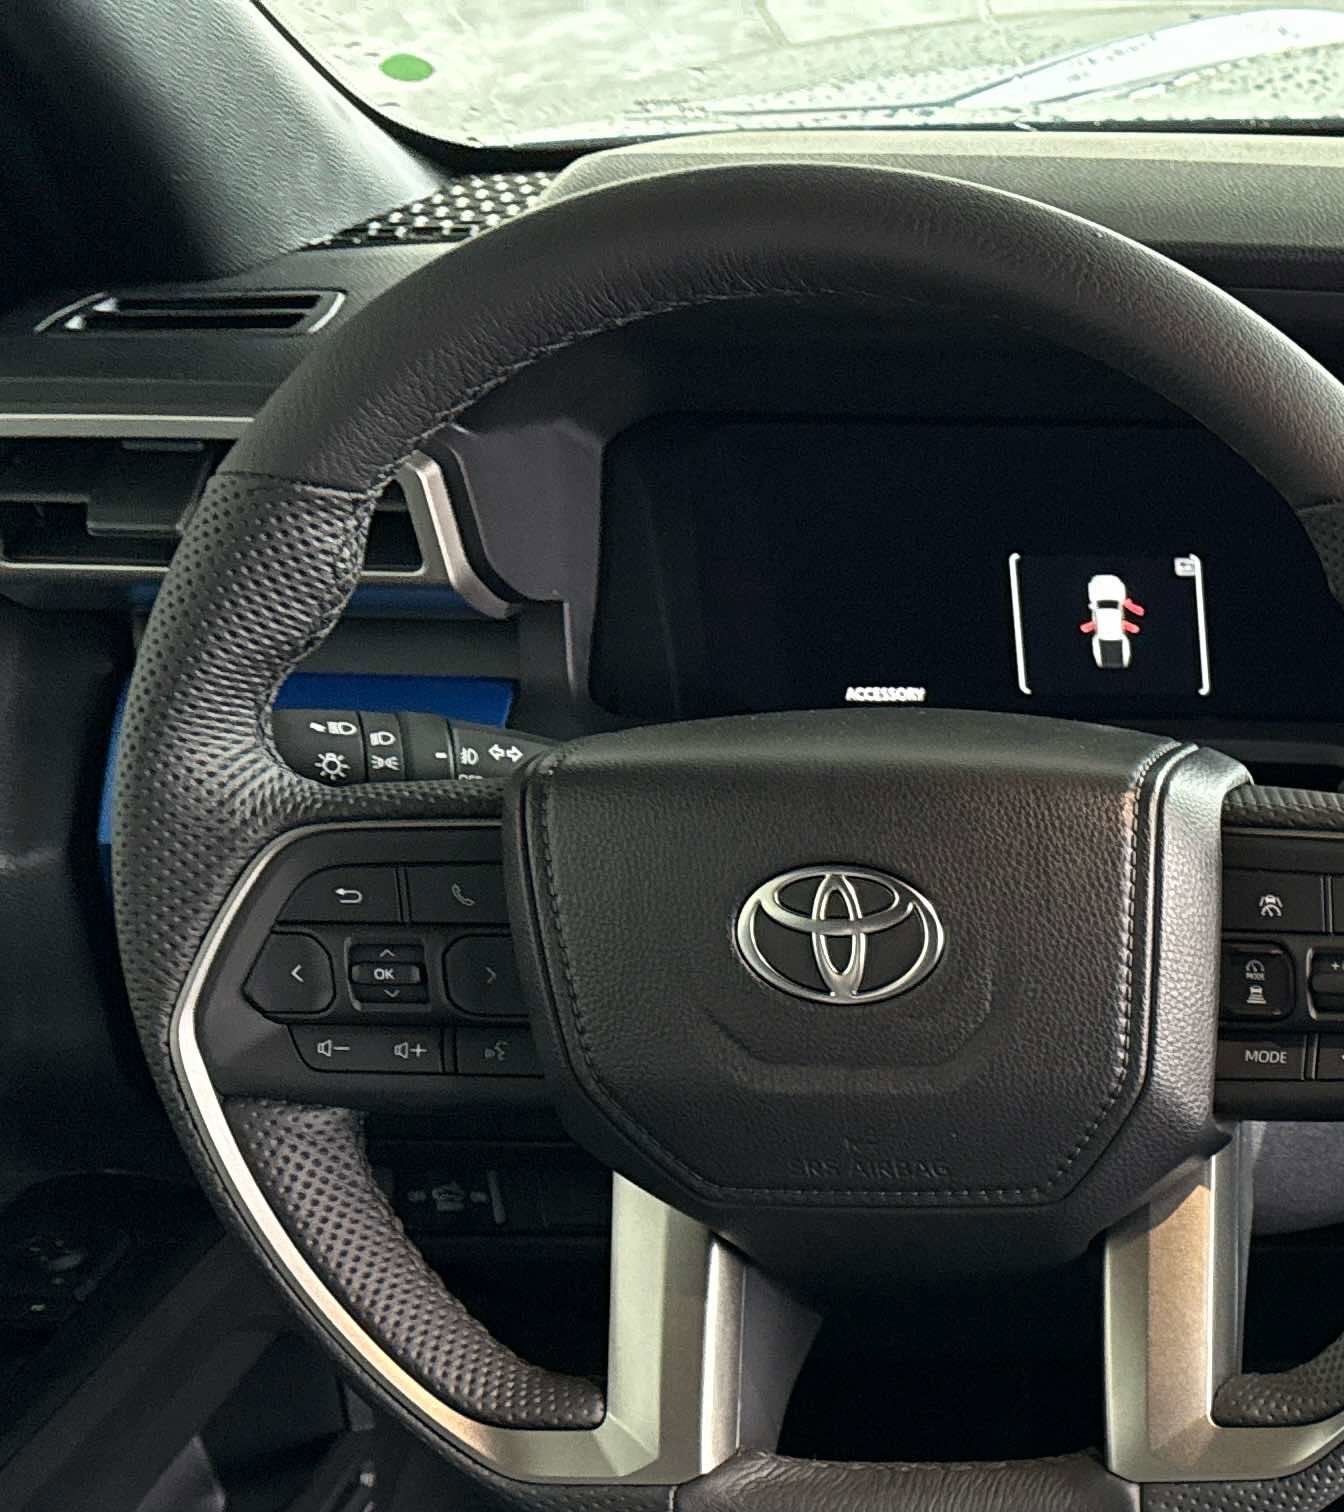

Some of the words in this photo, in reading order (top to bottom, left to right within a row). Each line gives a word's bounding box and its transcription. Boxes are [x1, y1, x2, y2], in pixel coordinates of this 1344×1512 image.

[845, 686, 926, 702] ACCESSORY
[373, 967, 395, 981] OK
[1244, 1049, 1288, 1064] MODE
